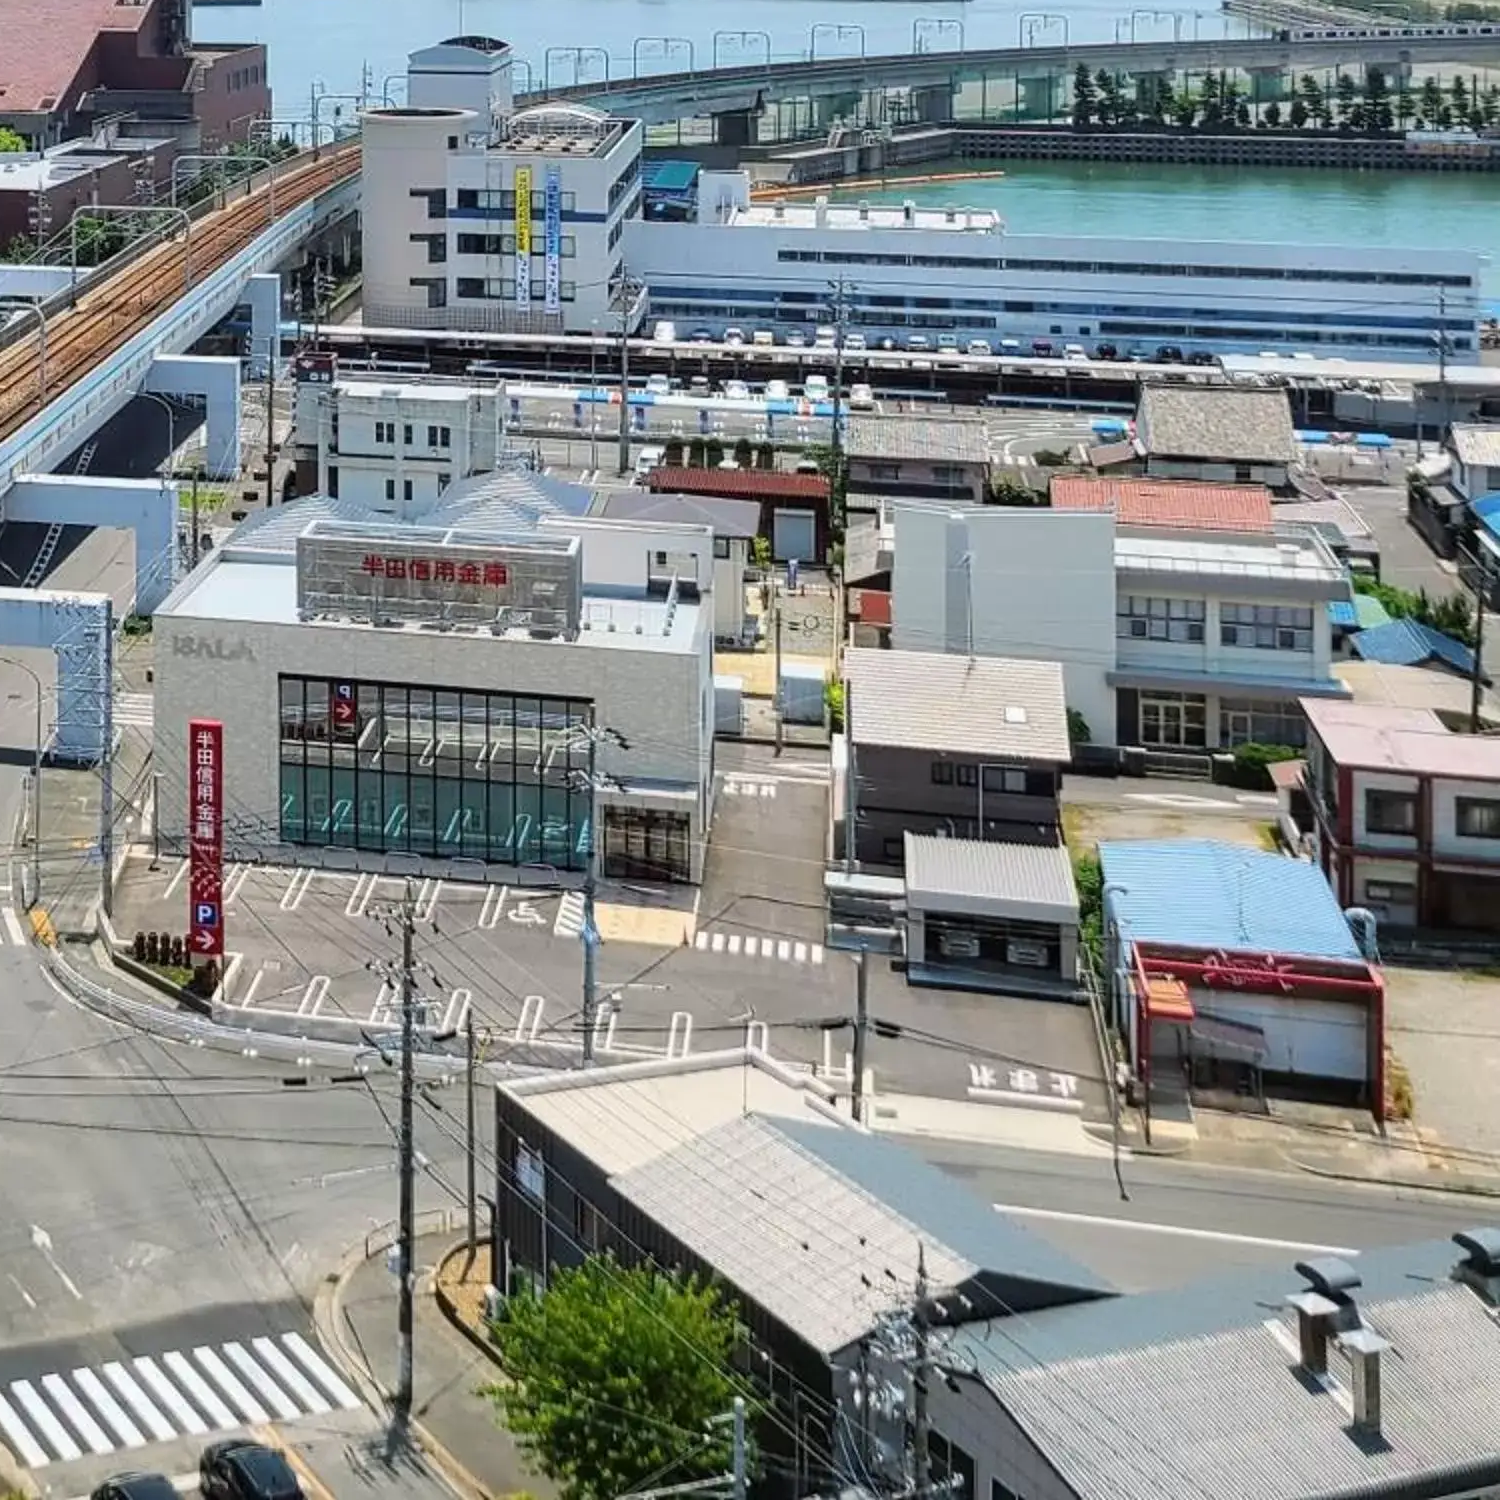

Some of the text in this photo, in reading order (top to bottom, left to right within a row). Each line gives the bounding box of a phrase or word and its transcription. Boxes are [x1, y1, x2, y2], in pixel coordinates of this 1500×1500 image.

[361, 553, 508, 587] 半田信用金庫
[195, 730, 216, 840] 半田信用金庫
[198, 904, 212, 923] P
